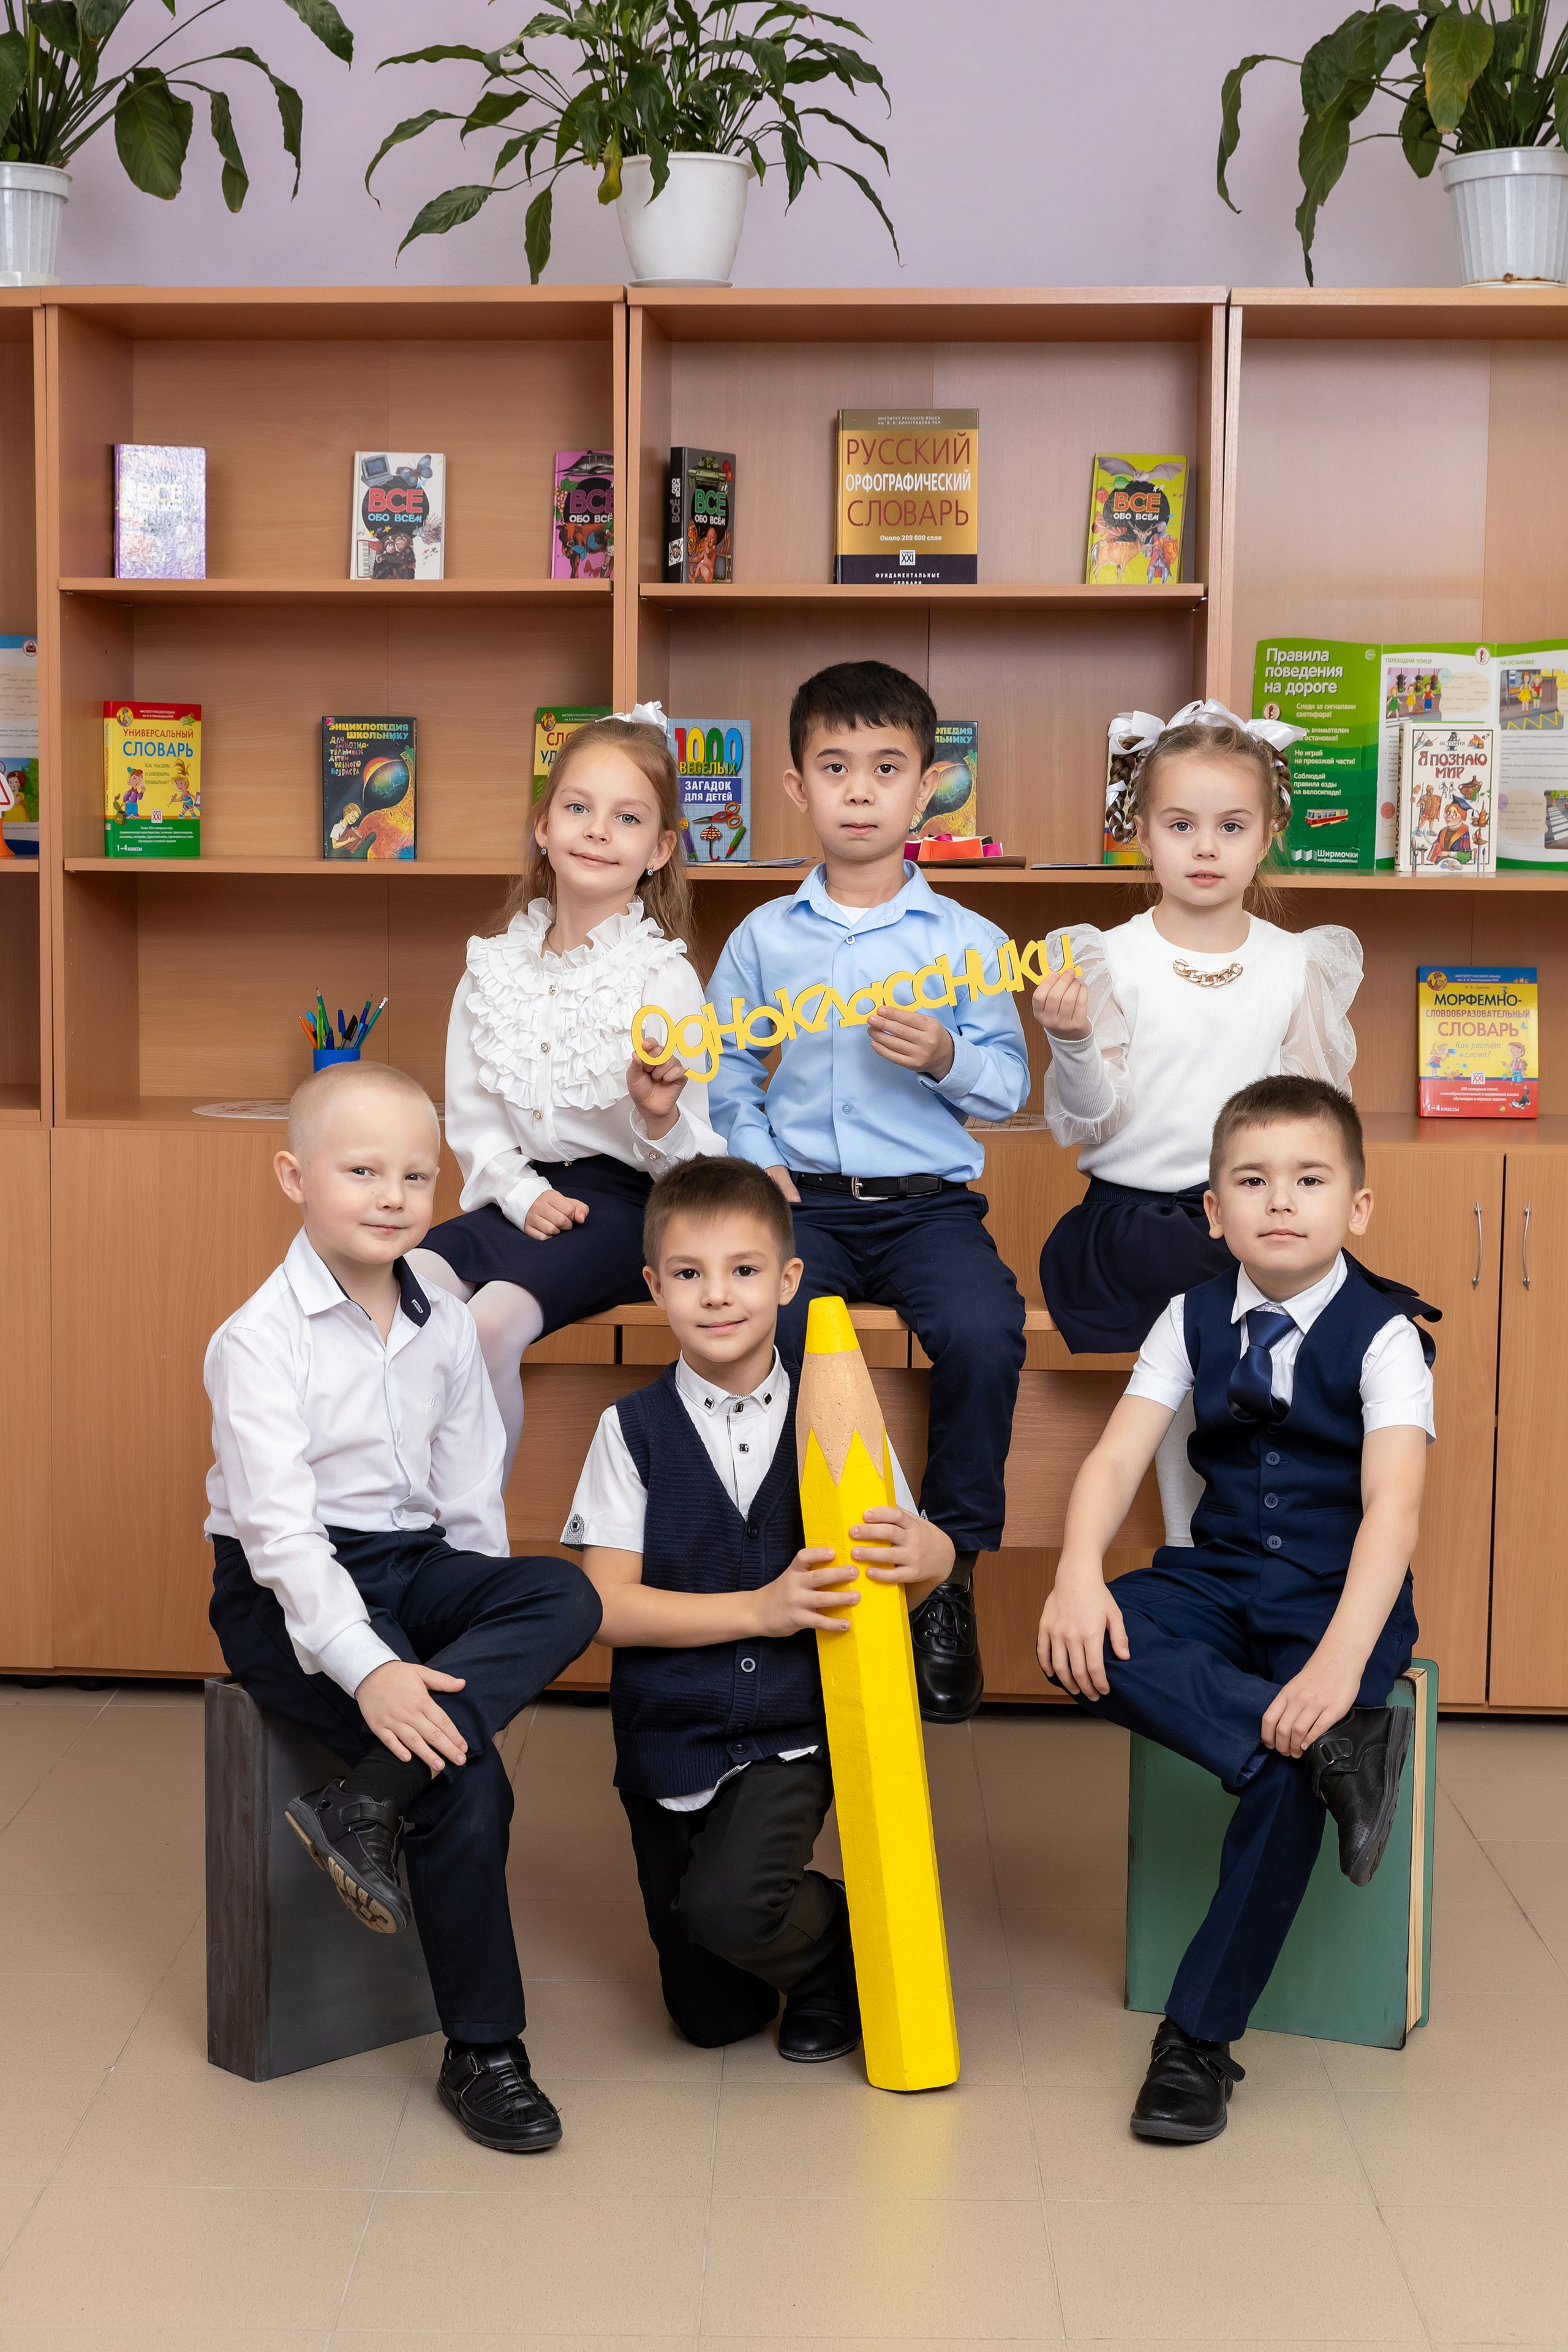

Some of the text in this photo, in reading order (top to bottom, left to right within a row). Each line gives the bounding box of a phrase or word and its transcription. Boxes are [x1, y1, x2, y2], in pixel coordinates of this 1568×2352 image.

[847, 432, 970, 466] РУССКИЙ
[845, 468, 971, 492] ОРФОГРАФИЧЕСКИЙ
[368, 512, 423, 523] ОБО ВСЁМ
[569, 513, 613, 523] ОБО ВСЁ
[695, 514, 708, 524] ОБО
[847, 499, 970, 527] СЛОВАРЬ
[1135, 512, 1159, 521] ВСЁМ
[901, 554, 914, 562] XXI
[1266, 647, 1330, 665] Правила
[1265, 666, 1343, 680] поведения
[1264, 682, 1338, 697] на дороге
[329, 723, 409, 731] ЭНЦИКЛОПЕДИЯ
[123, 728, 194, 739] УНИВЕРСАЛЬНЫЙ
[346, 731, 409, 740] ШКОЛЬНИКУ
[123, 741, 194, 758] СЛОВАРЬ
[674, 726, 744, 772] 1000
[1418, 750, 1488, 766] Я ПОЗНАЮ
[331, 767, 360, 777] ВОЗРАСТА
[679, 761, 737, 775] ВЕСЕЛЫХ
[1435, 766, 1466, 778] МИР
[685, 780, 731, 792] ЗАГАДОК
[684, 791, 733, 802] ДЛЯ ДЕТЕЙ
[1317, 849, 1359, 859] Ширмочки
[1434, 993, 1522, 1006] МОРФЕМНО-
[1426, 1008, 1531, 1018] СЛОВООБРАЗОВАТЕЛЬНЫЙ
[1438, 1021, 1519, 1037] СЛОВАРЬ
[1471, 1041, 1501, 1050] растёт
